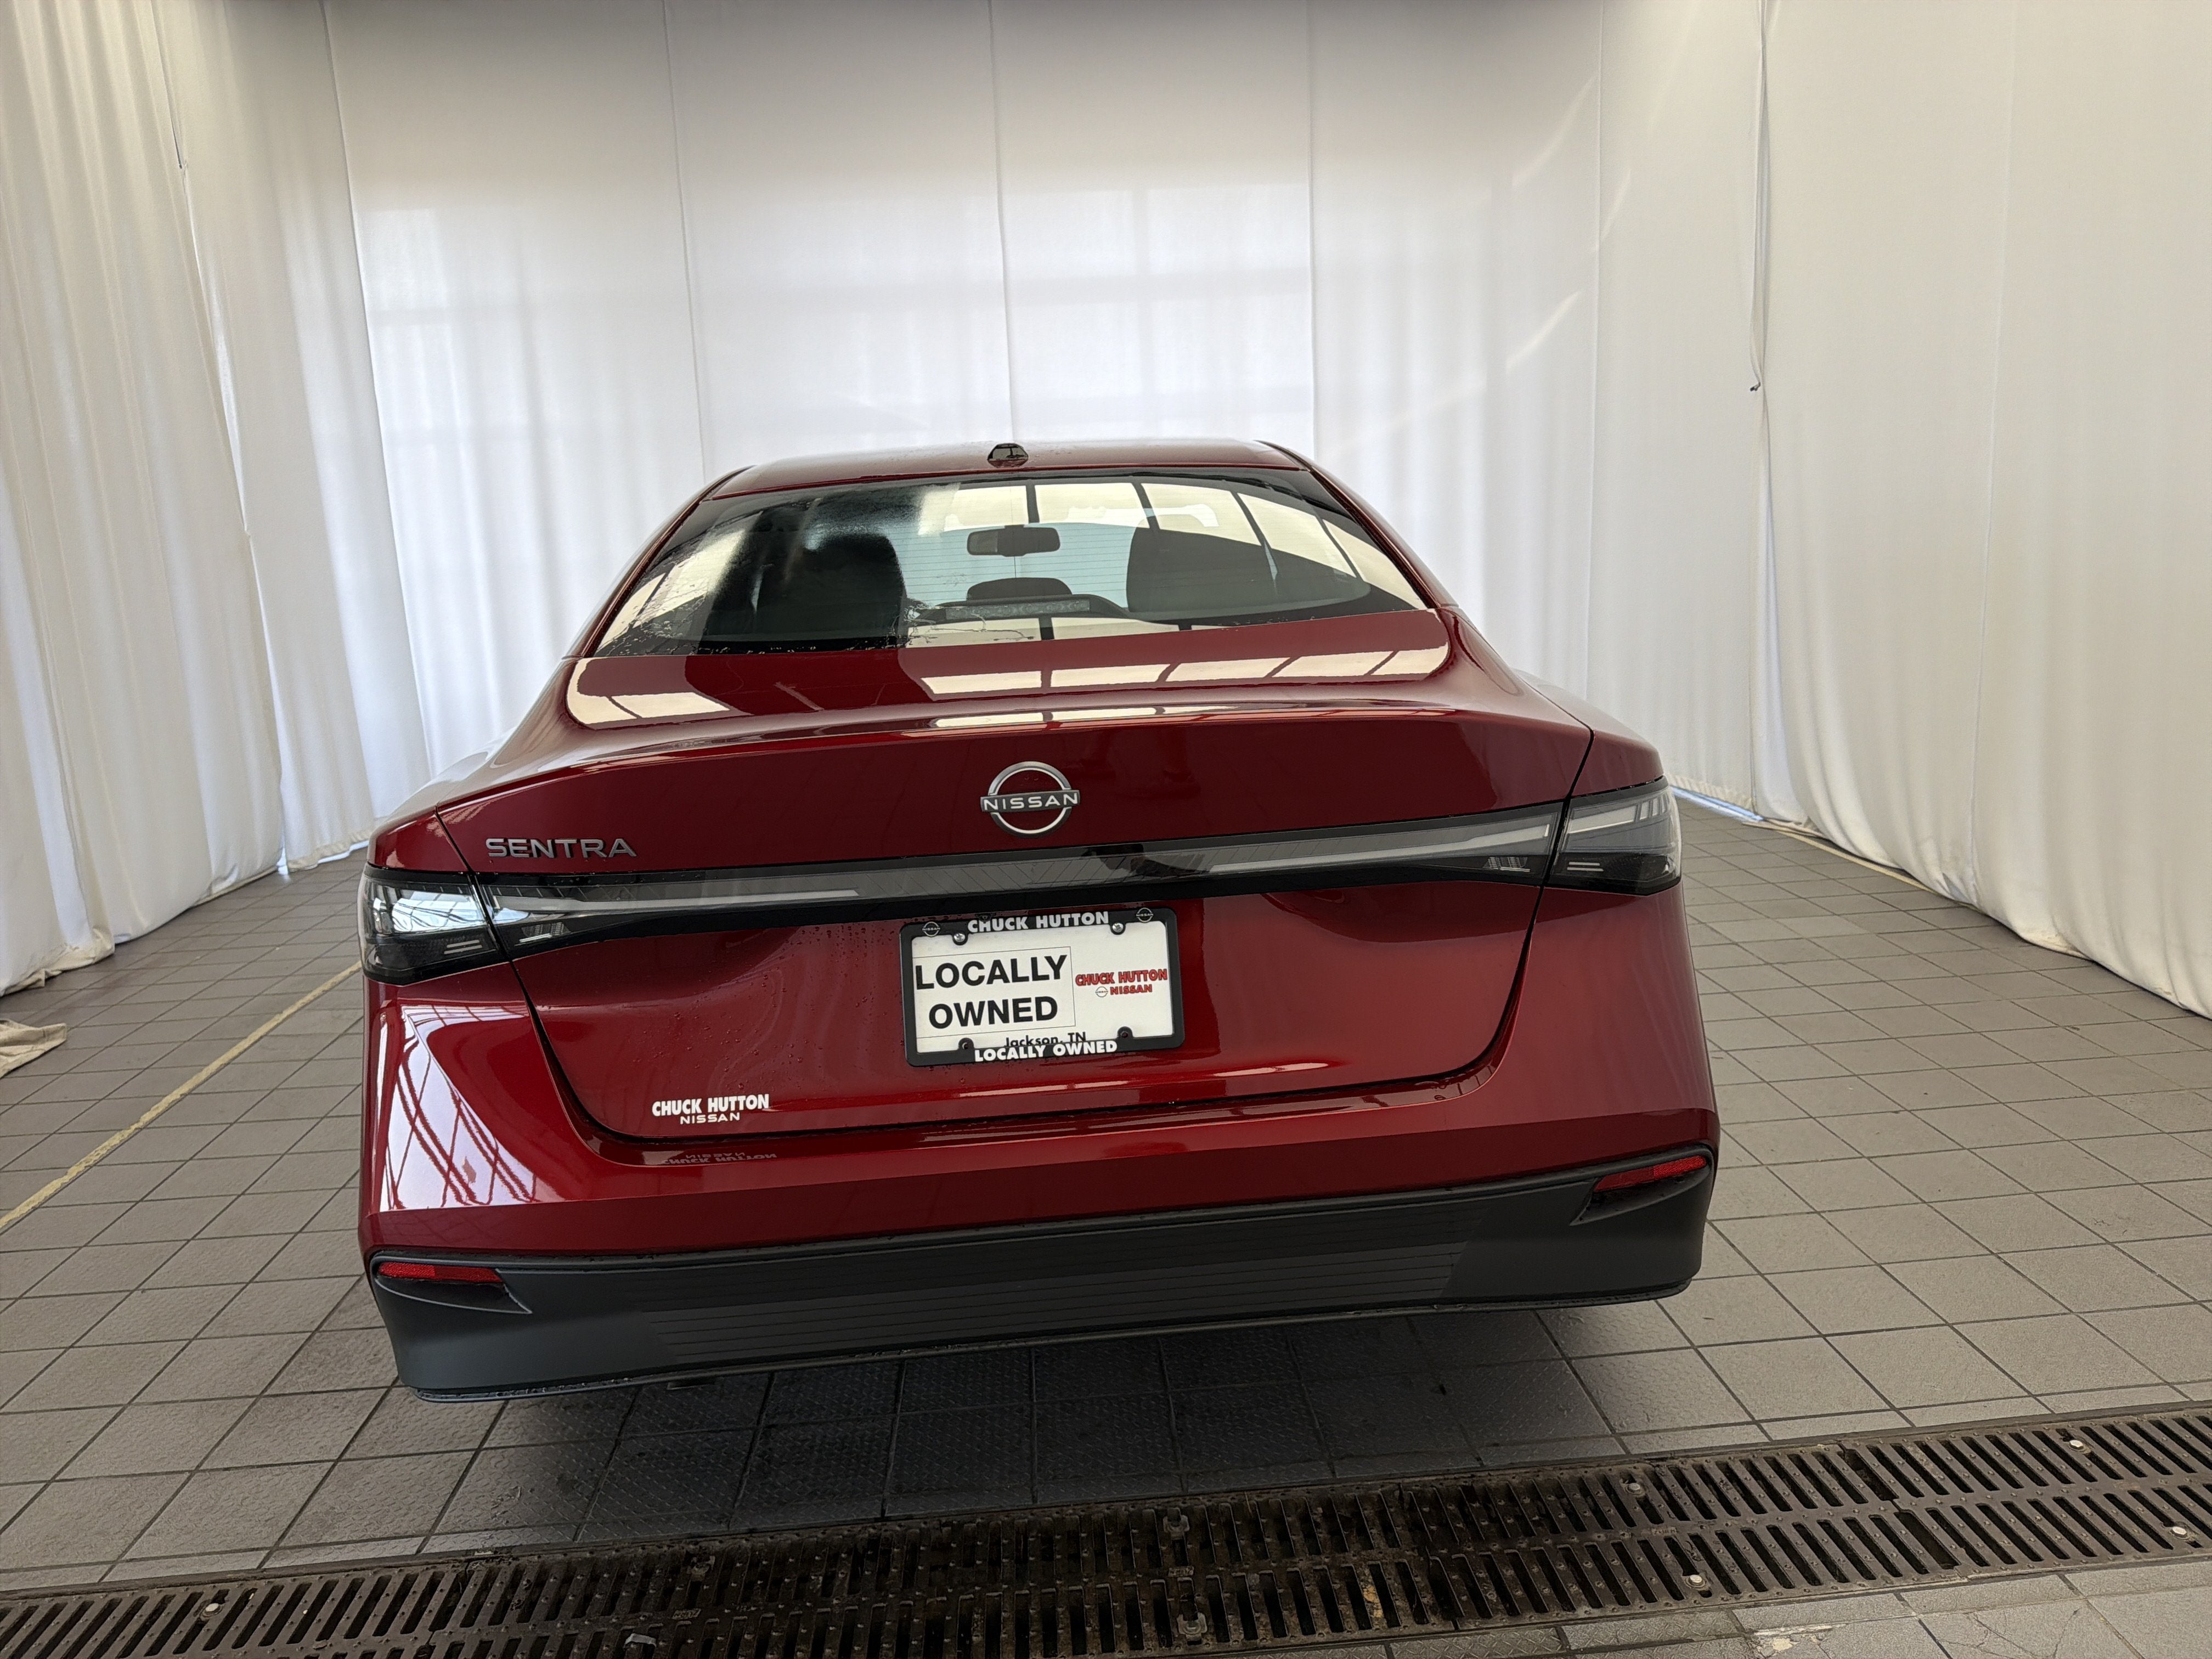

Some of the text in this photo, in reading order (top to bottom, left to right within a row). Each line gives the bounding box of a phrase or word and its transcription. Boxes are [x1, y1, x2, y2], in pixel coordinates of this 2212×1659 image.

[983, 793, 1078, 811] NISSAN
[486, 838, 637, 858] SENTRA
[967, 911, 1109, 933] CHUCK HUTTON
[915, 955, 1068, 990] LOCALLY
[1075, 968, 1168, 986] CHUCK HUTTON
[1110, 984, 1153, 996] NISSAN
[928, 996, 1058, 1029] OWNED
[1068, 1031, 1086, 1042] TN
[974, 1040, 1118, 1062] LOCALLY OWNED
[652, 1093, 770, 1117] CHUCK HUTTON
[680, 1112, 741, 1125] NISSAN
